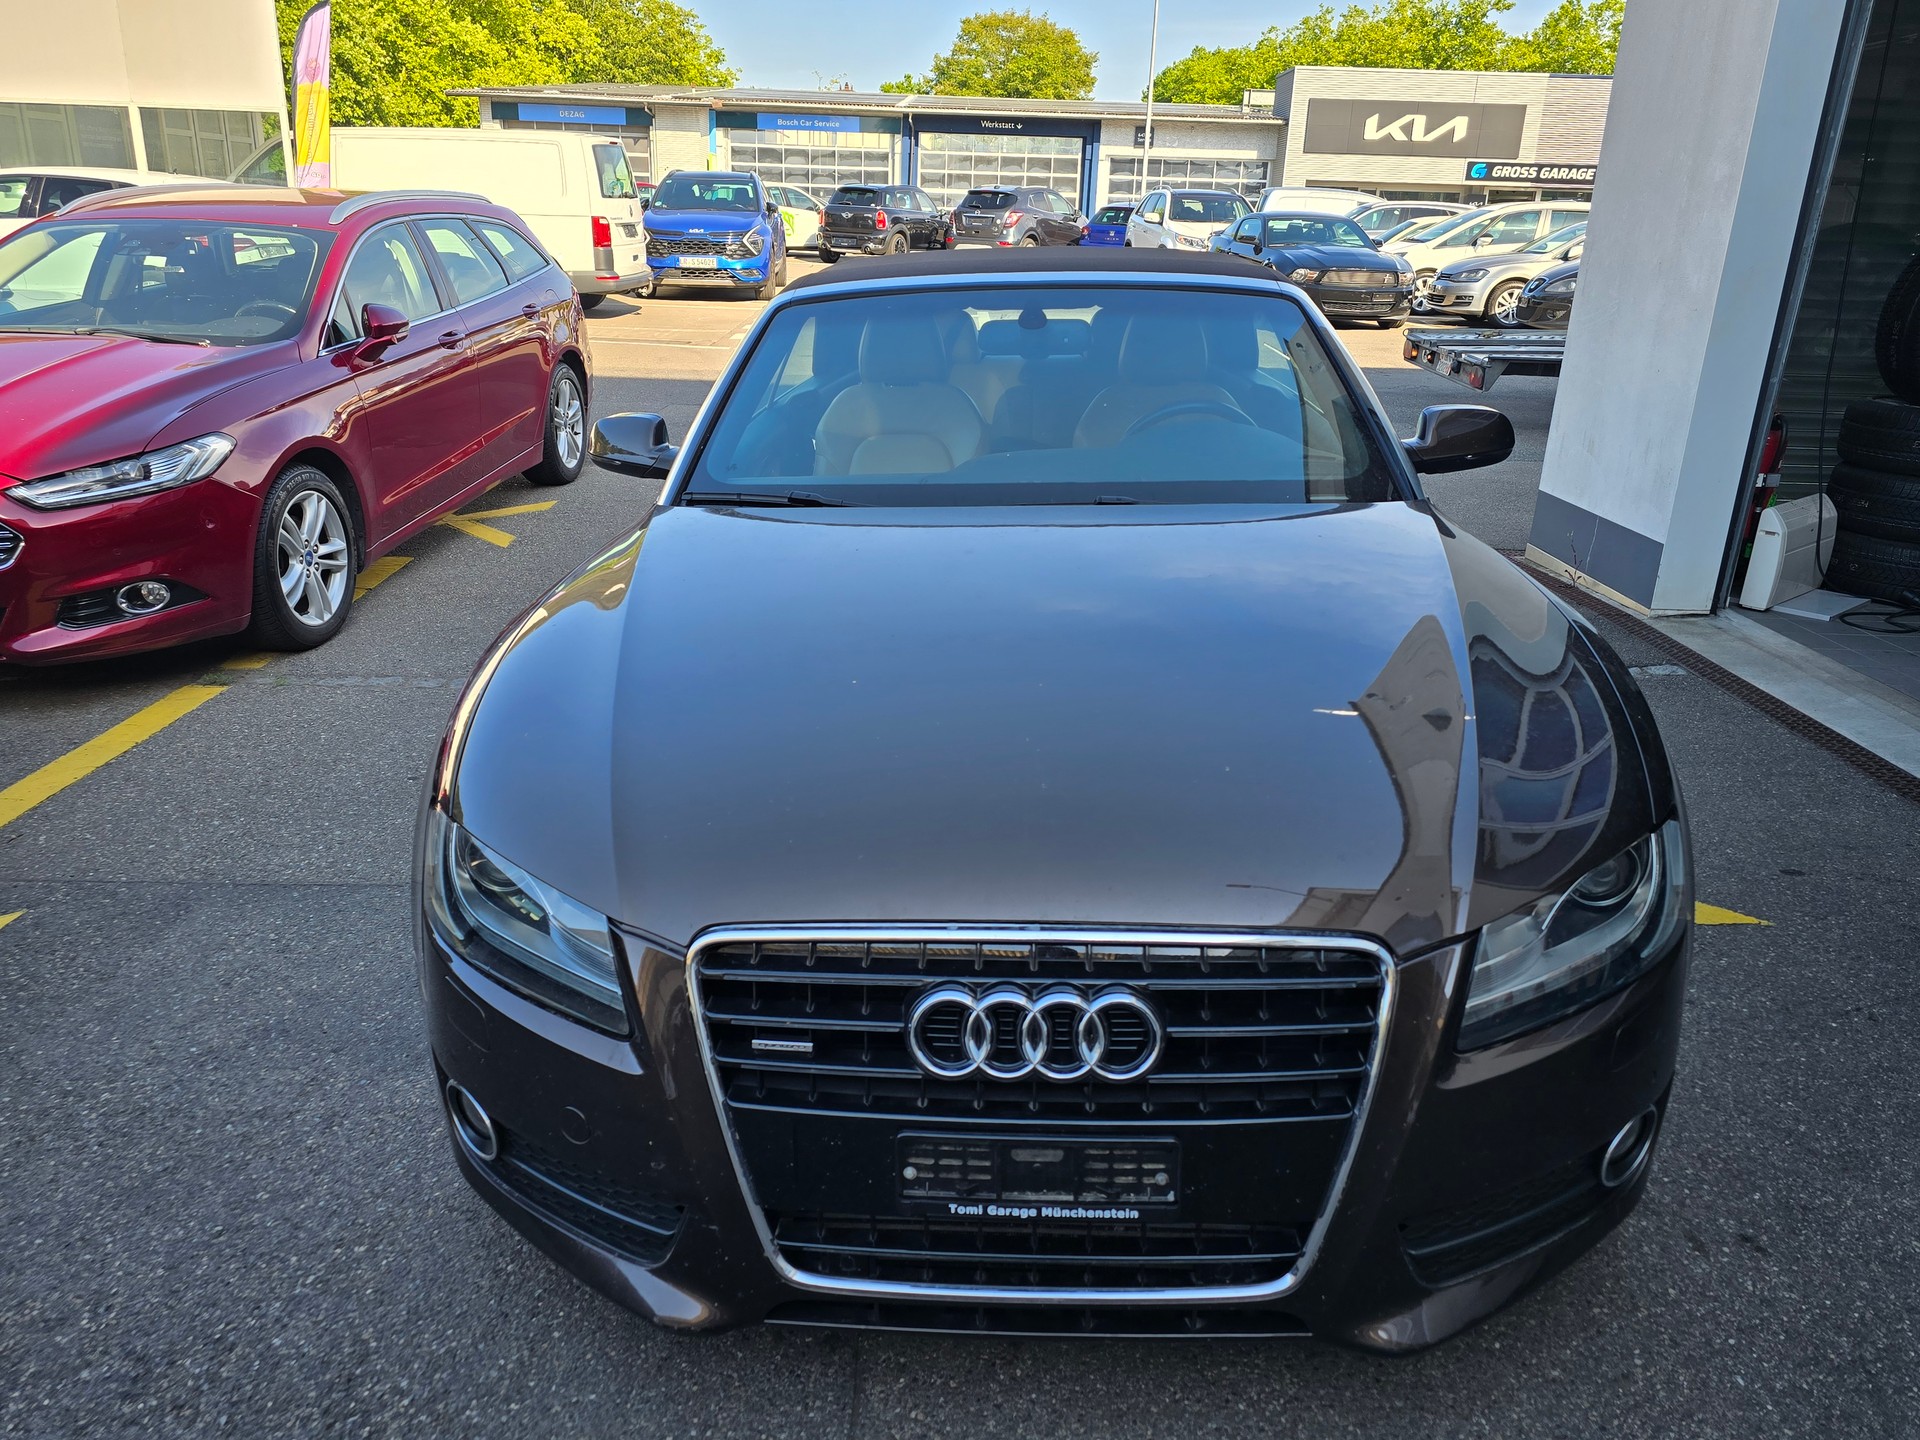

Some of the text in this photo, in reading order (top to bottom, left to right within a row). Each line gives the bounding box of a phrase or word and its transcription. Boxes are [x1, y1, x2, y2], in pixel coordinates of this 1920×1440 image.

[559, 110, 585, 118] DEZAG
[777, 118, 840, 128] Bosch Car Service
[980, 120, 1015, 129] Werkstatt
[1363, 114, 1470, 143] KIA
[1491, 165, 1597, 180] GROSS GARAGE
[986, 1204, 1037, 1219] Garage
[1041, 1206, 1140, 1219] Münchenstein
